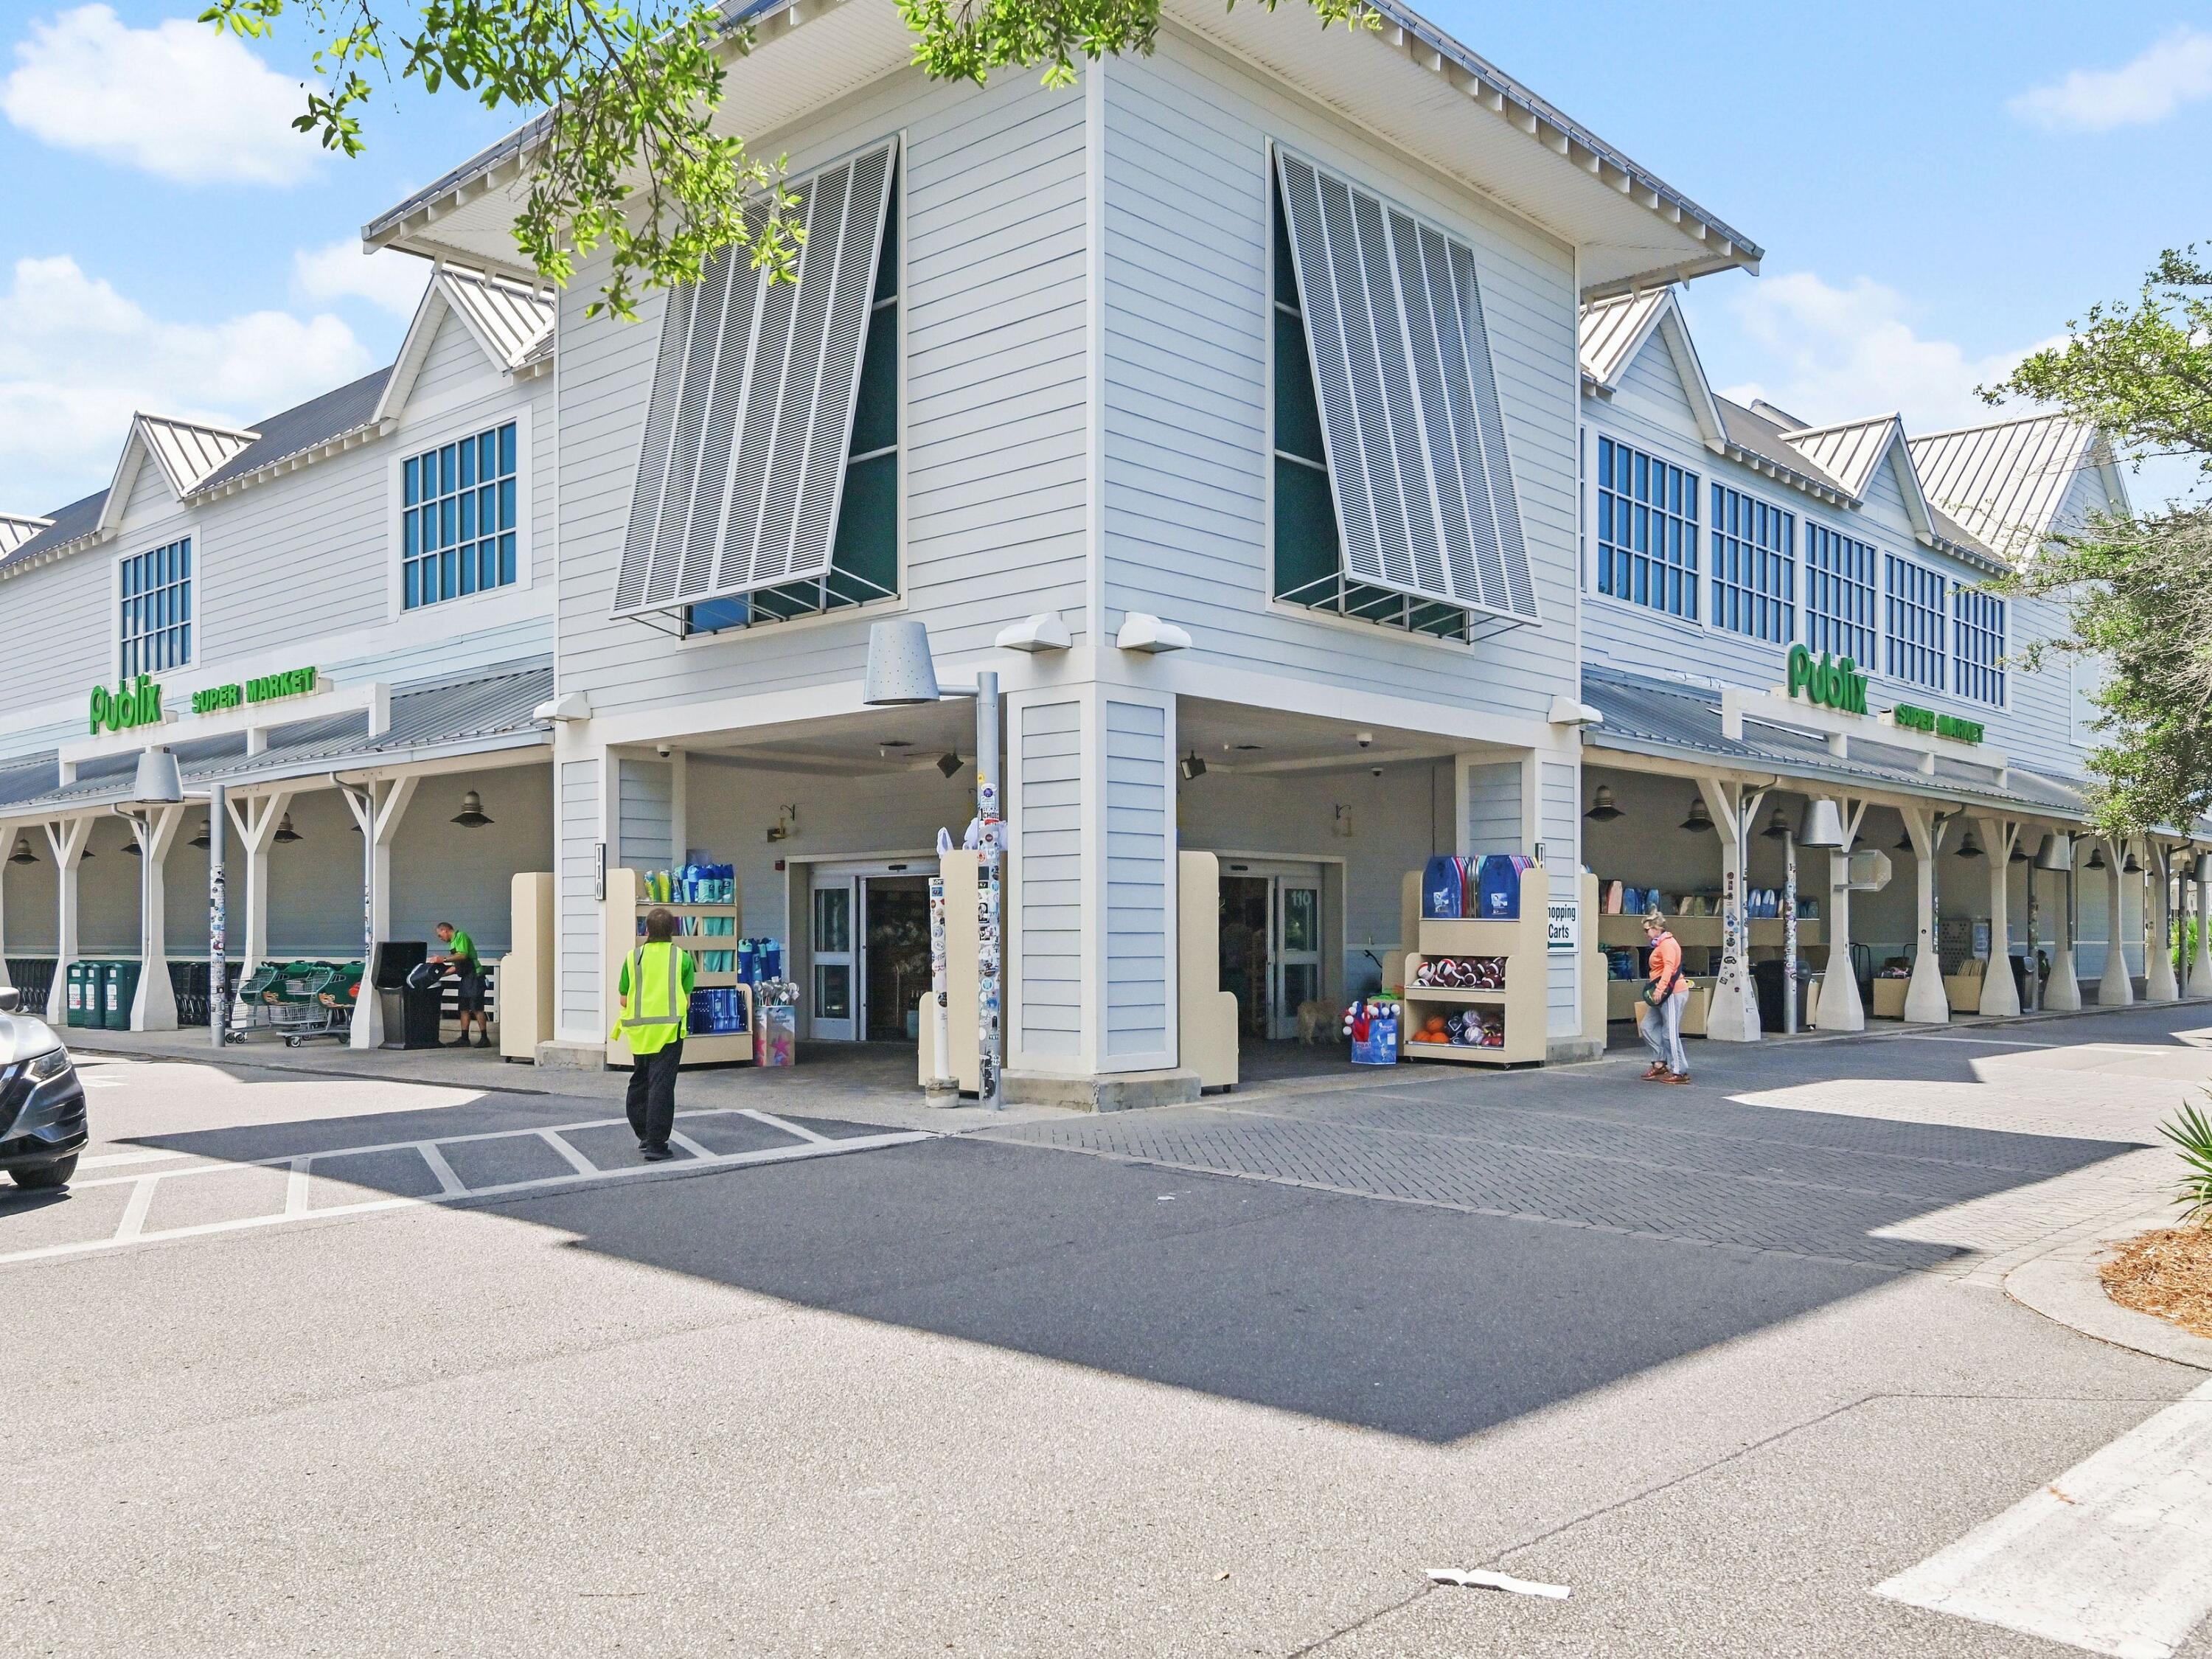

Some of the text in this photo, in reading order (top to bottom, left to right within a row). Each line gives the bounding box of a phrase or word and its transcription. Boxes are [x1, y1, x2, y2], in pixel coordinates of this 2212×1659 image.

[192, 666, 316, 713] SUPER MARKET
[1788, 644, 1868, 715] Publix
[90, 672, 161, 734] Publix
[1896, 703, 1984, 743] SUPER MARKET
[1291, 890, 1312, 906] 110
[1548, 923, 1569, 939] Carts
